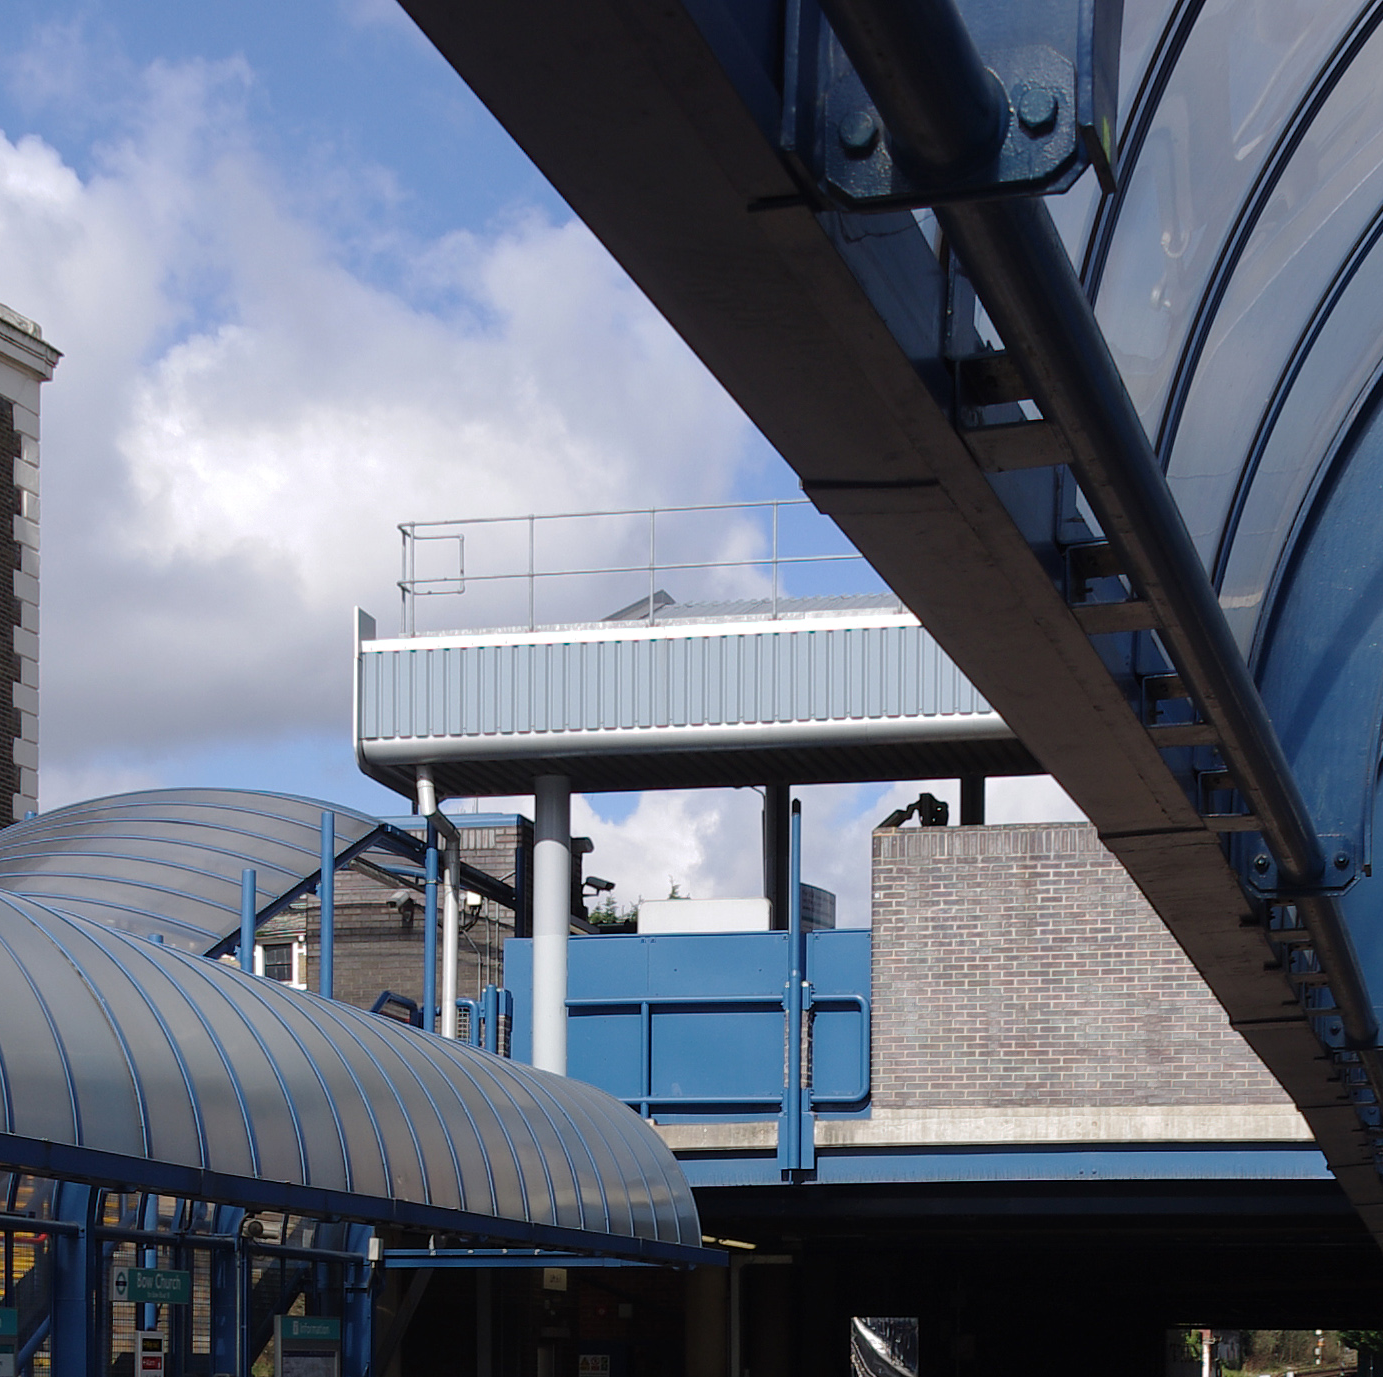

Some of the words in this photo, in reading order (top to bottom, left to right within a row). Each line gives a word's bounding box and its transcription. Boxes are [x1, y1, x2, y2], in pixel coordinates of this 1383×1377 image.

[137, 1272, 154, 1289] Bow
[155, 1273, 181, 1290] Church
[299, 1322, 330, 1335] Information
